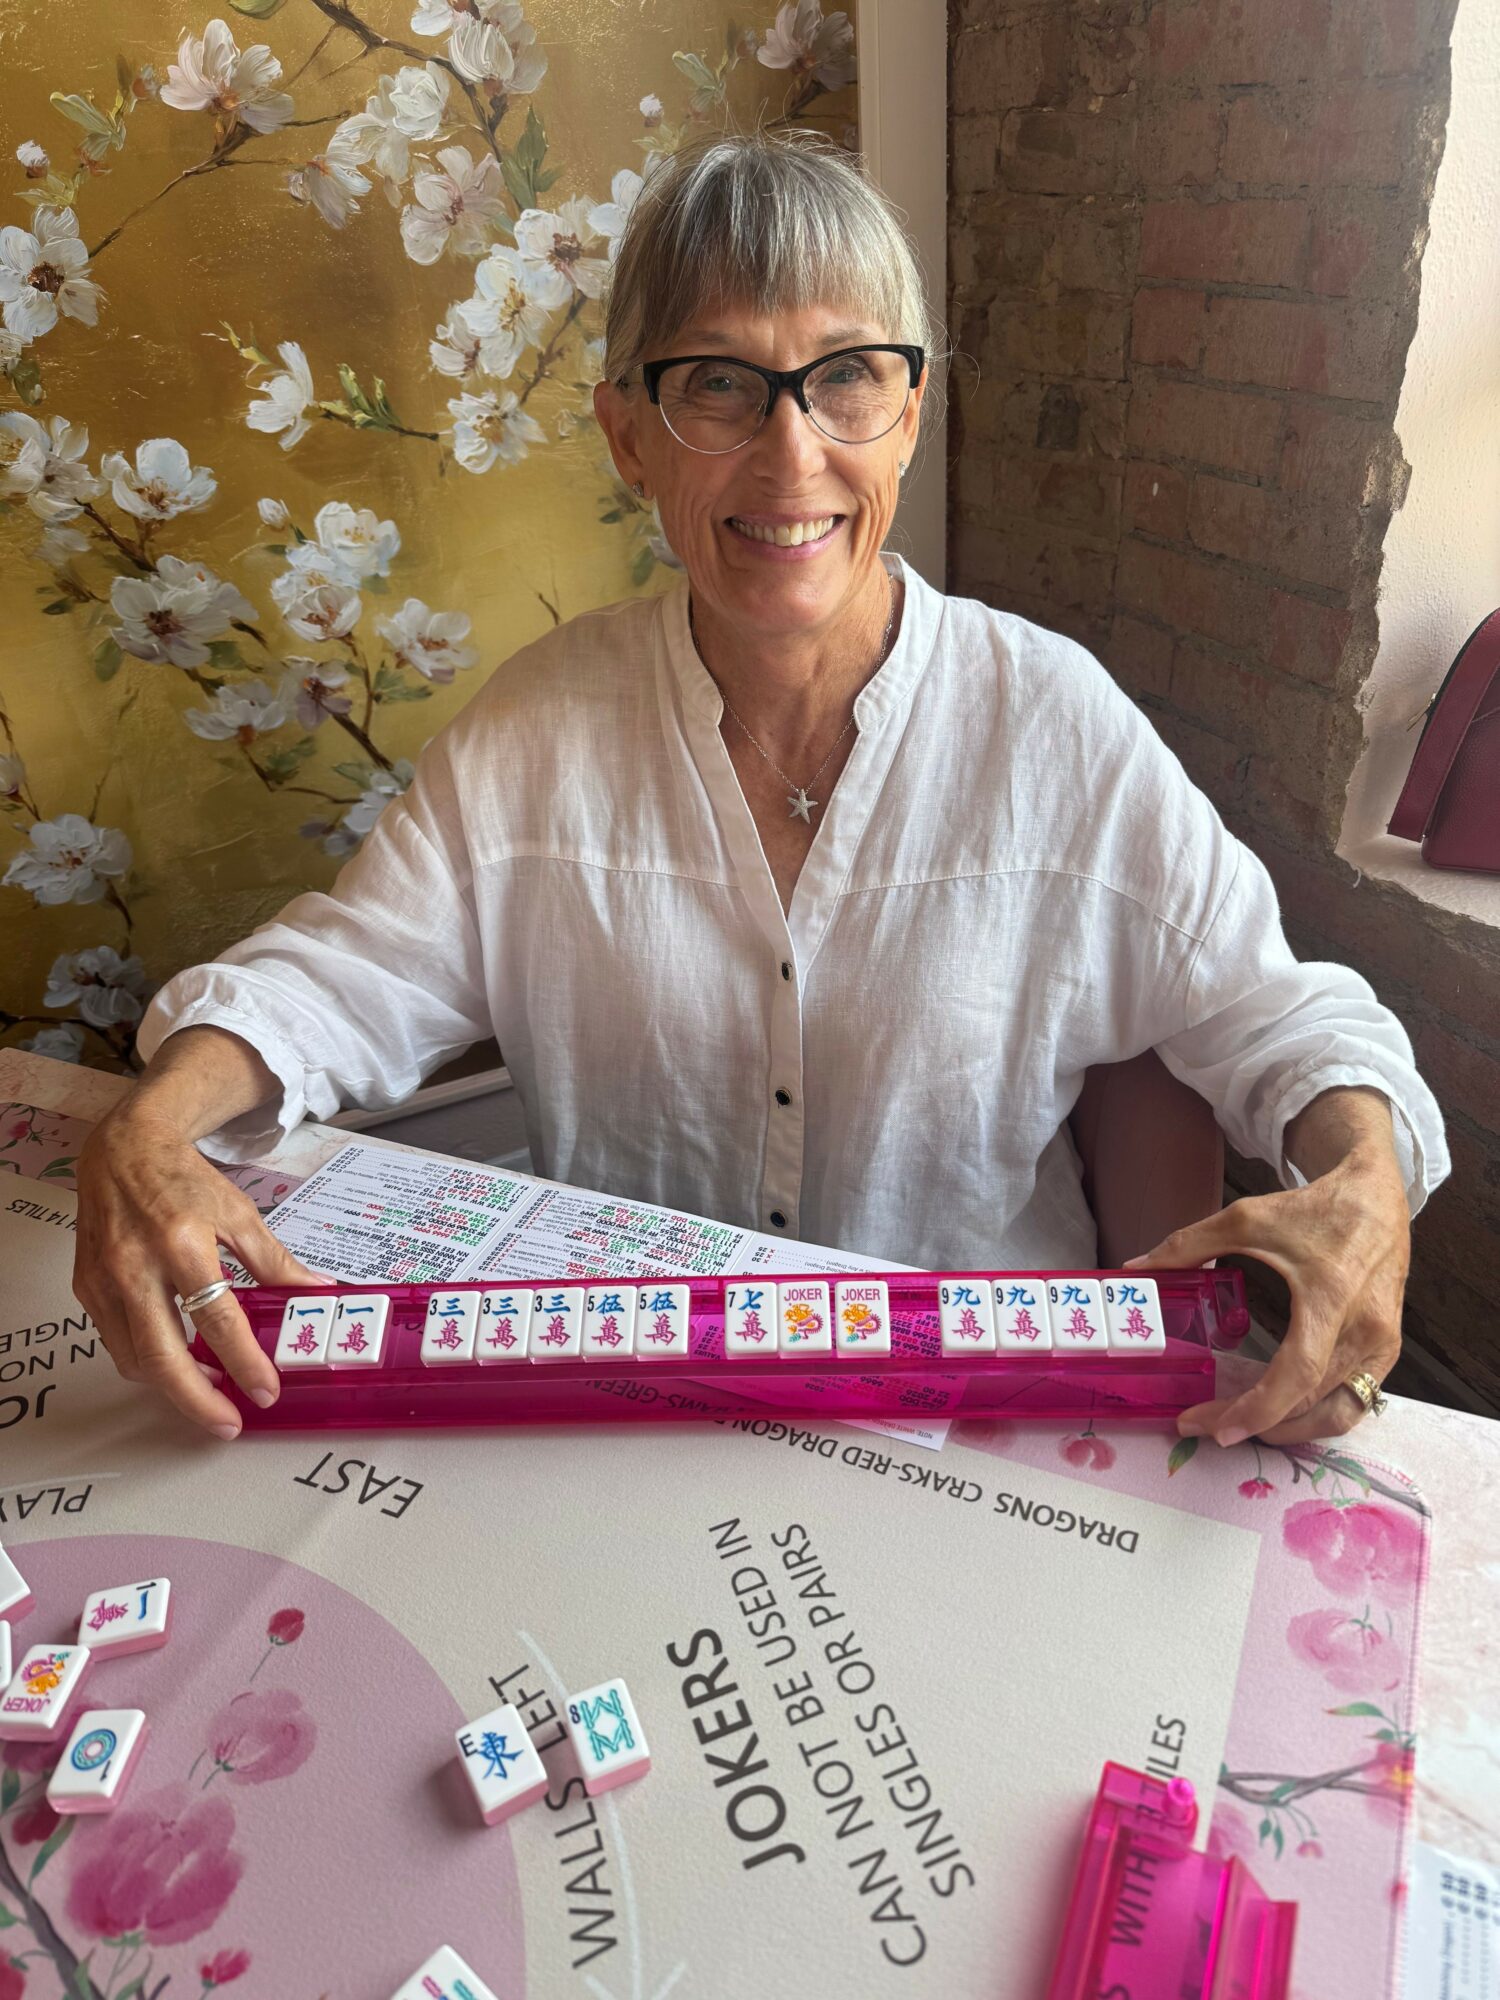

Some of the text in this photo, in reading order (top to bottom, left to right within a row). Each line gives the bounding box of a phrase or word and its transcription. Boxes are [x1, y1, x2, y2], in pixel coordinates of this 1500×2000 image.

[5, 1199, 50, 1220] TILES
[45, 1211, 70, 1225] 14
[413, 1208, 436, 1216] NEWS
[305, 1259, 368, 1278] WINDS DRAGONS
[639, 1295, 647, 1310] 5
[728, 1291, 736, 1308] 7
[783, 1288, 823, 1302] JOKER
[841, 1288, 881, 1302] JOKER
[941, 1288, 949, 1304] 9
[996, 1287, 1003, 1304] 9
[1050, 1287, 1058, 1303] 9
[1106, 1286, 1114, 1302] 9
[337, 1303, 344, 1319] 1
[429, 1299, 438, 1316] 3
[482, 1298, 491, 1315] 3
[534, 1296, 543, 1313] 3
[587, 1296, 595, 1311] 5
[288, 1305, 295, 1321] 1
[841, 1443, 983, 1503] CRAKS-RED
[294, 1451, 423, 1519] EAST
[993, 1491, 1140, 1554] DRAGONS
[136, 1581, 157, 1590] 1
[3, 1697, 52, 1713] JOKER
[770, 1522, 976, 1898] SINGLES OR PAIRS
[569, 1705, 581, 1724] 8
[459, 1733, 478, 1758] E
[666, 1628, 805, 1870] JOKERS
[708, 1516, 928, 1968] CAN NOT BE USED IN
[477, 1731, 524, 1780] 東
[100, 1760, 111, 1781] 1
[488, 1663, 618, 1969] WALLS LEFT
[1110, 1850, 1160, 1948] WITH
